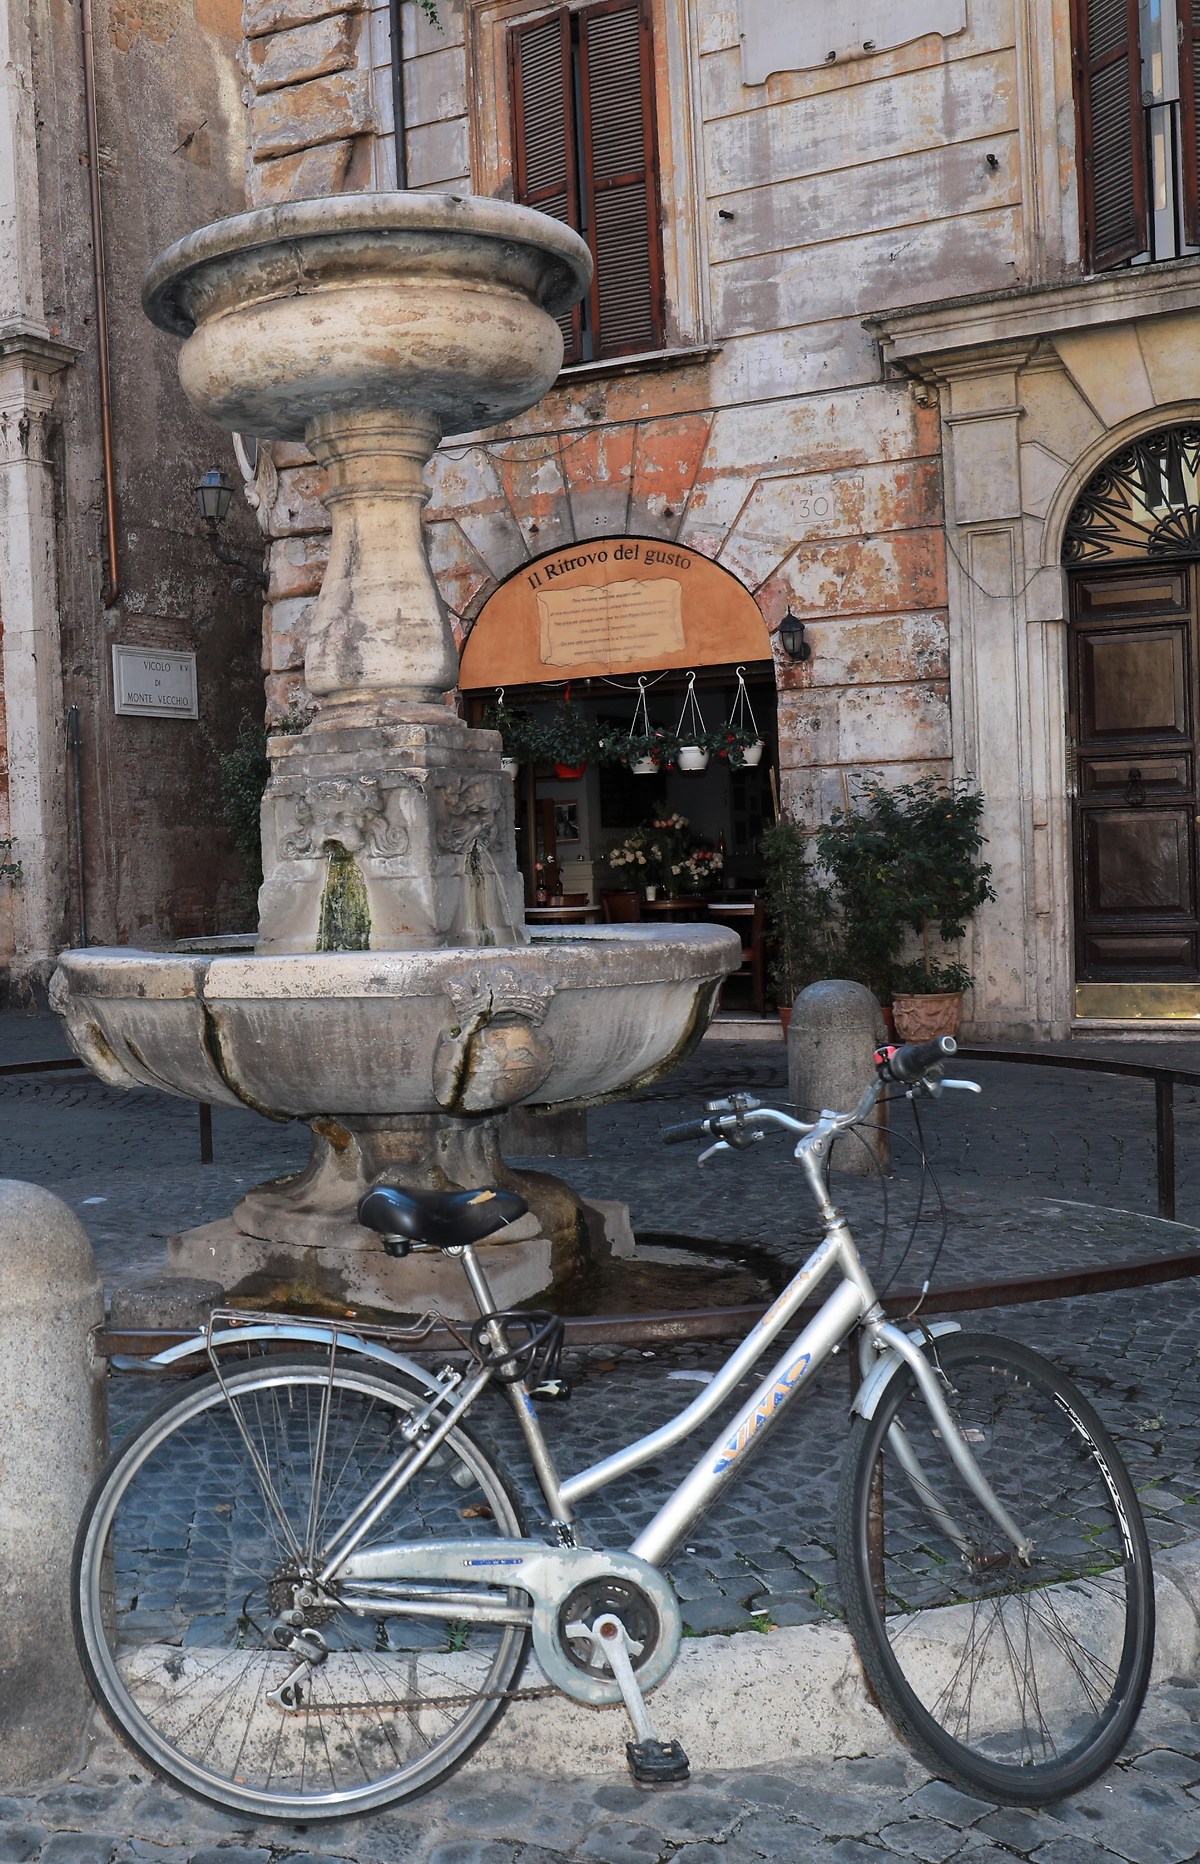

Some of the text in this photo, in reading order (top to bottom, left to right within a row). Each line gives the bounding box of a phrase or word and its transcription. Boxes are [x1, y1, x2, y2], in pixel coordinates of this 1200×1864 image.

[799, 496, 829, 518] 30
[526, 544, 691, 590] Il Ritrovo del gusto
[143, 661, 171, 672] VICOLO
[154, 679, 161, 687] DI
[127, 692, 189, 706] MONTE VECCHIO
